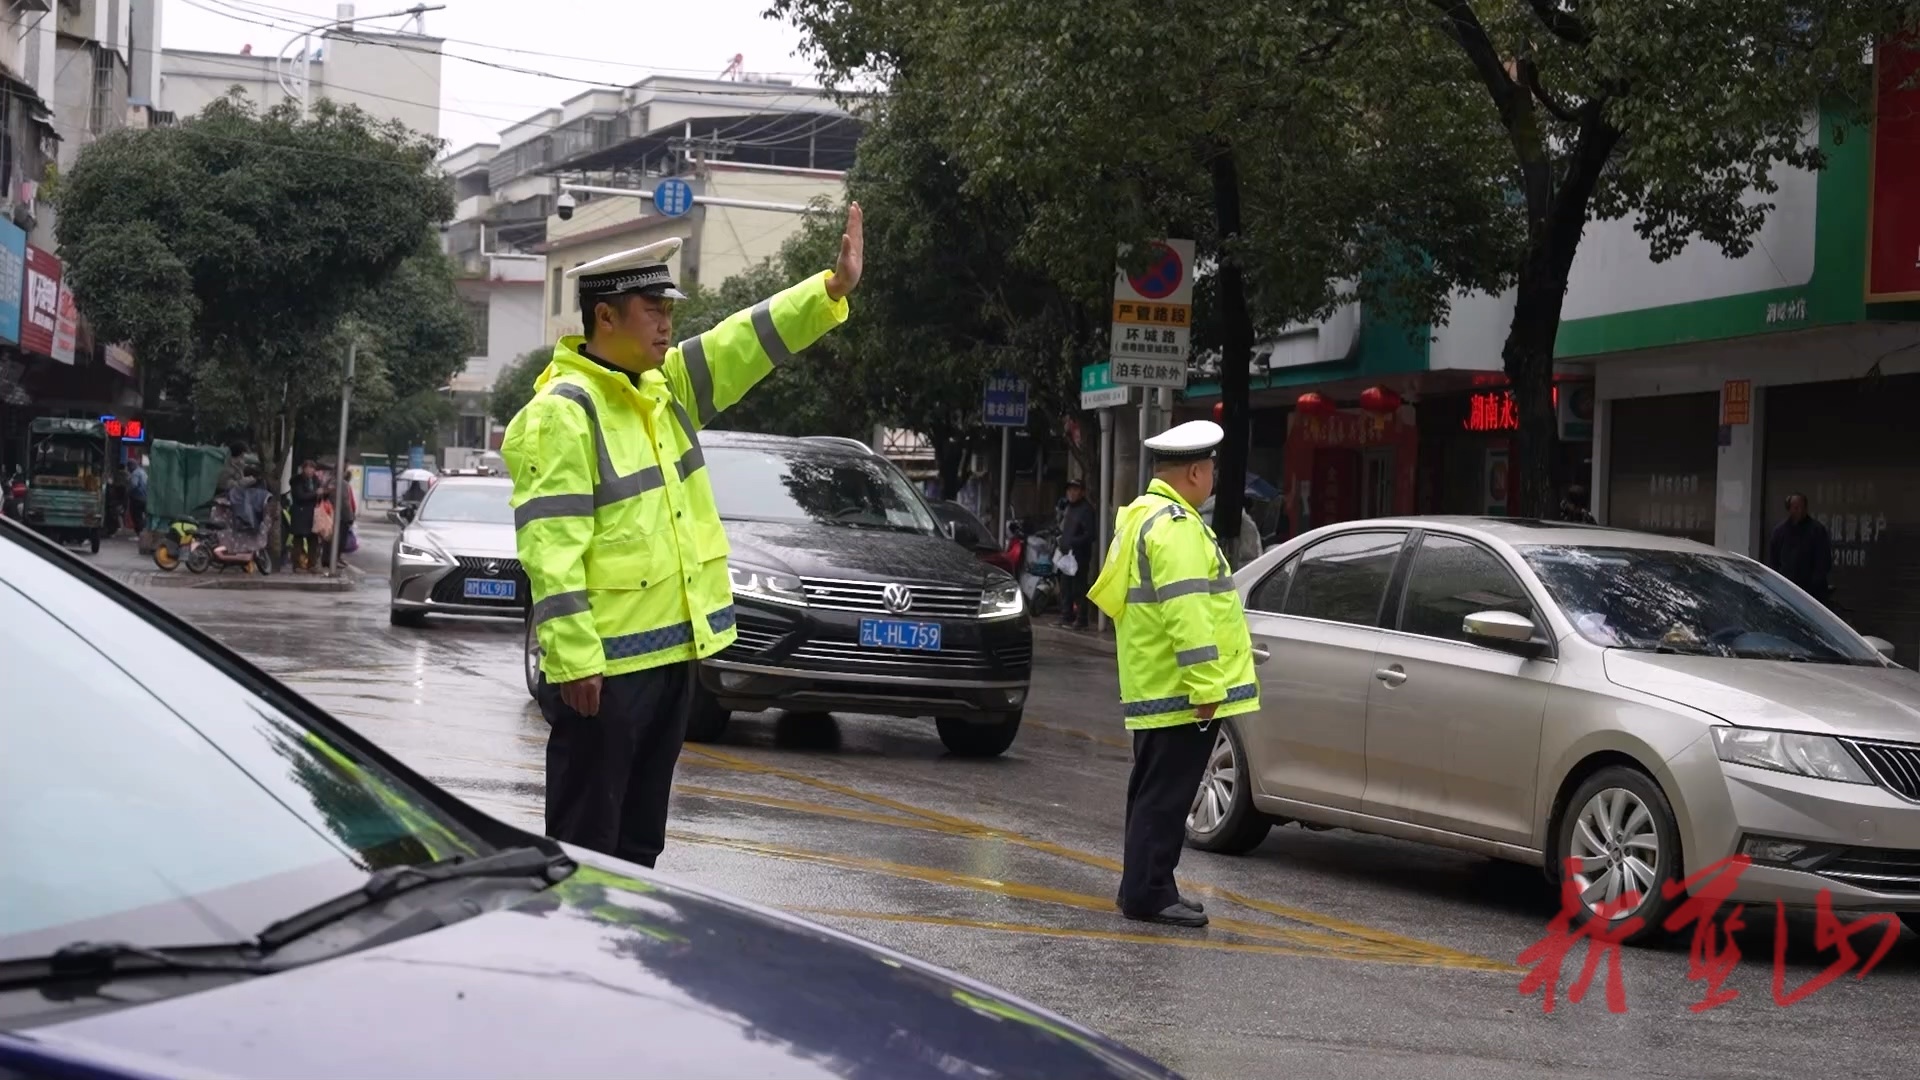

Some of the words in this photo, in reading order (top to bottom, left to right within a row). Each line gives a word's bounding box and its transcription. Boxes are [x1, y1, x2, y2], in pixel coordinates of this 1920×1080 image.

[1119, 304, 1185, 323] 严管路段
[1126, 328, 1175, 343] 环城路
[1116, 363, 1181, 380] 泊车位除外
[1464, 391, 1518, 430] 湖南永
